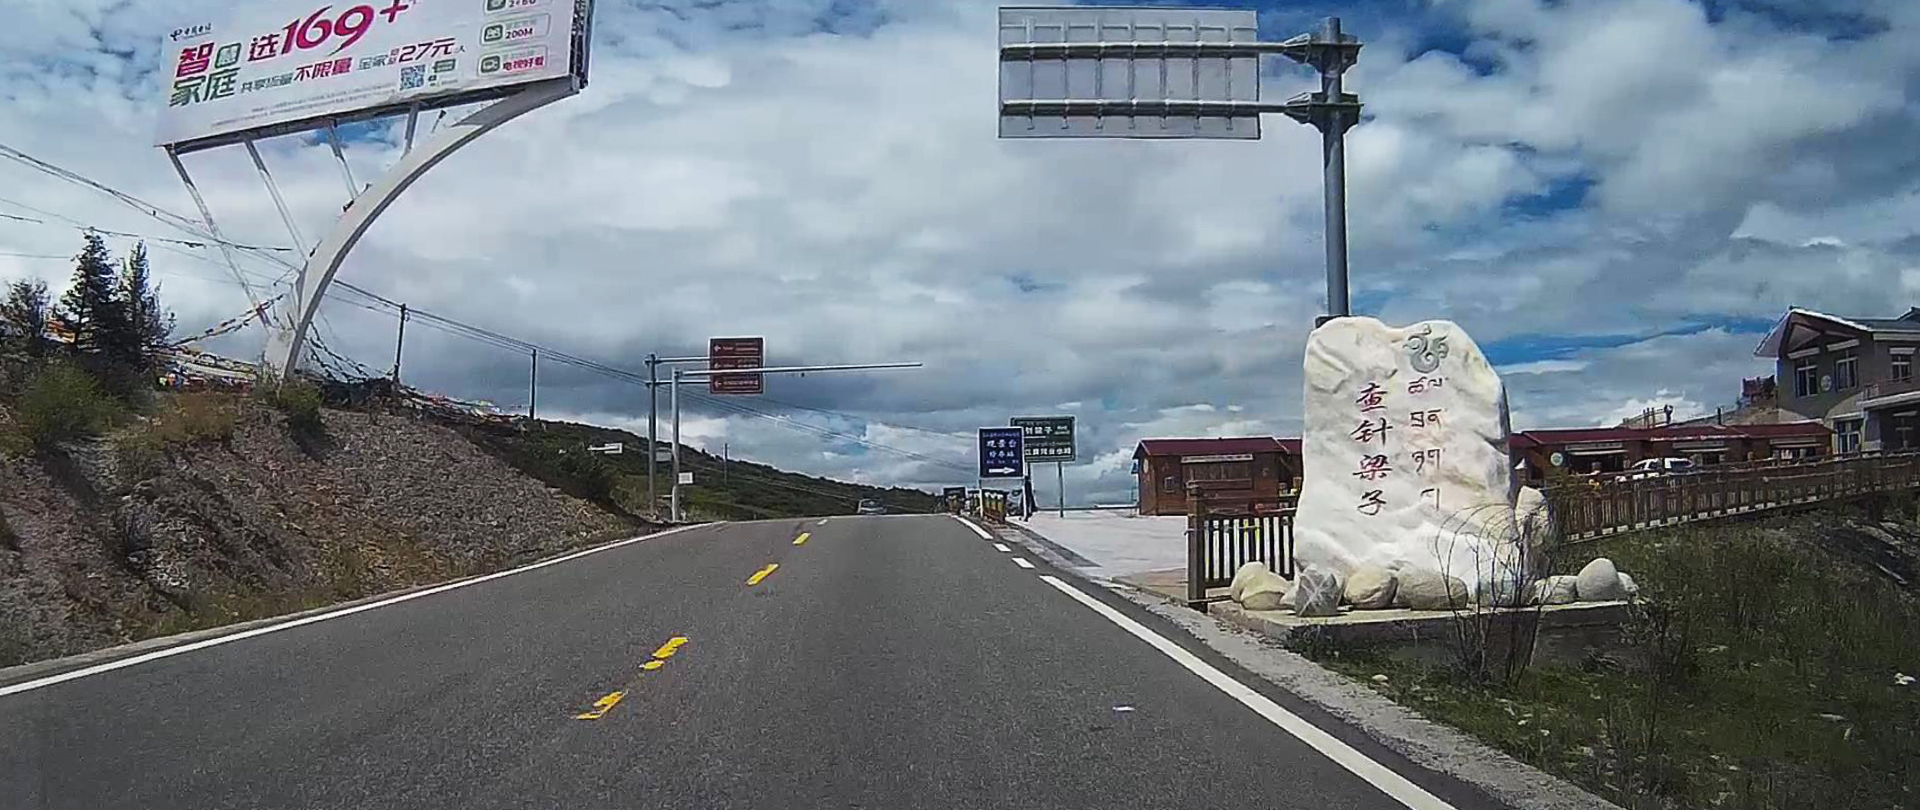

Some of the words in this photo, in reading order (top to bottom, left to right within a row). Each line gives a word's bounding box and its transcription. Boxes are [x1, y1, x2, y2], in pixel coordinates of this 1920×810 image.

[505, 27, 533, 39] 200M
[169, 67, 241, 107] 家庭
[1350, 382, 1394, 517] 查针梁子
